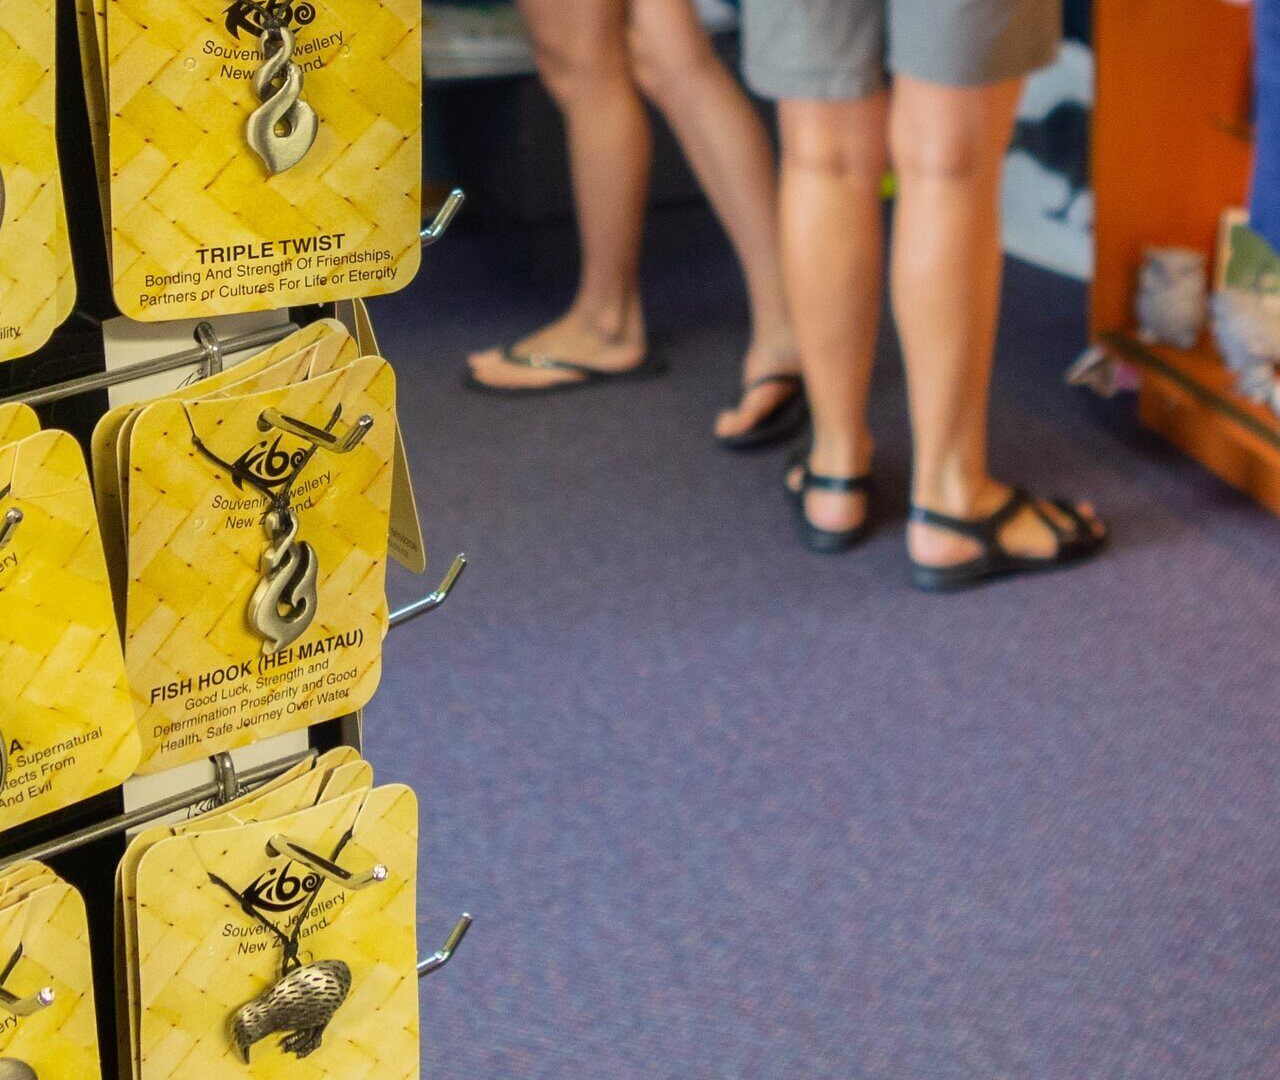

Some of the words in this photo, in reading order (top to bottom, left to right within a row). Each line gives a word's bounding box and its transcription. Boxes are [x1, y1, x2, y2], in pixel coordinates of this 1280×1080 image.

[202, 39, 269, 61] Souveni
[292, 30, 345, 58] wellery
[220, 64, 256, 80] New
[196, 240, 275, 266] TRIPLE
[278, 232, 347, 257] TWIST
[145, 267, 202, 289] Bonding
[205, 265, 234, 281] And
[236, 257, 294, 278] Strength
[296, 255, 313, 270] Of
[316, 248, 395, 268] Friendships,
[139, 288, 197, 308] Partners
[200, 290, 215, 302] or
[218, 281, 275, 300] Cultures
[278, 277, 301, 291] For
[304, 272, 328, 288] Life
[330, 273, 345, 285] or
[348, 266, 399, 284] Eternity
[211, 494, 268, 511] Souvenir
[225, 515, 255, 530] New
[150, 677, 193, 705] FISH
[198, 660, 253, 691] HOOK
[258, 648, 293, 676] (HEI
[297, 627, 364, 662] MATAU)
[185, 694, 218, 712] Good
[221, 681, 252, 701] Luck,
[256, 665, 304, 690] Strength
[307, 658, 329, 675] and
[153, 703, 237, 739] Determination
[240, 685, 299, 717] Prosperity
[301, 677, 324, 694] and
[326, 666, 358, 686] Good
[160, 732, 203, 755] Health,
[206, 723, 233, 740] Safe
[236, 707, 283, 731] Journey
[286, 699, 314, 716] Over
[317, 687, 350, 705] Water
[16, 725, 104, 769] Supernatural
[41, 755, 77, 778] From
[28, 780, 54, 800] Evil
[237, 940, 268, 955] New
